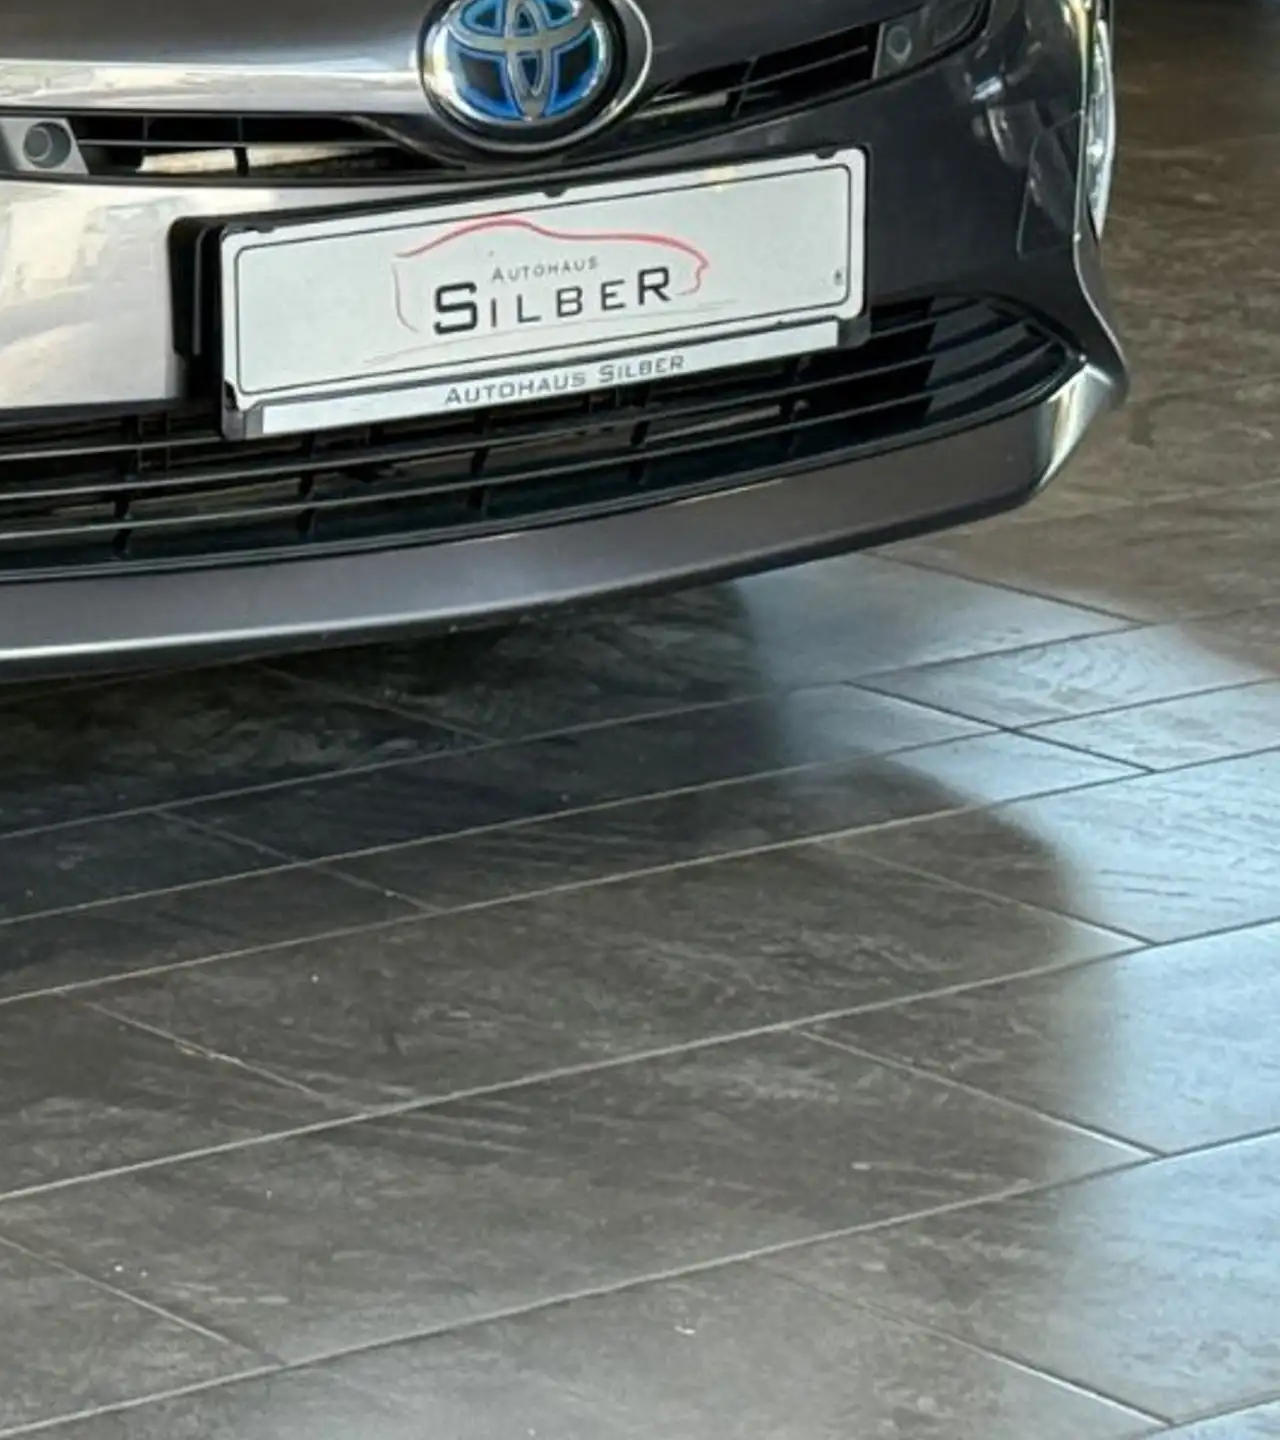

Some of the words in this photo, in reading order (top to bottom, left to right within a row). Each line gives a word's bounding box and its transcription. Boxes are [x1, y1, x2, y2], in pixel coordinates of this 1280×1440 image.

[491, 255, 600, 282] AUTOHAUS
[433, 266, 671, 336] SILBER
[444, 372, 587, 406] AUTOHAUS
[598, 355, 685, 385] SILBER
